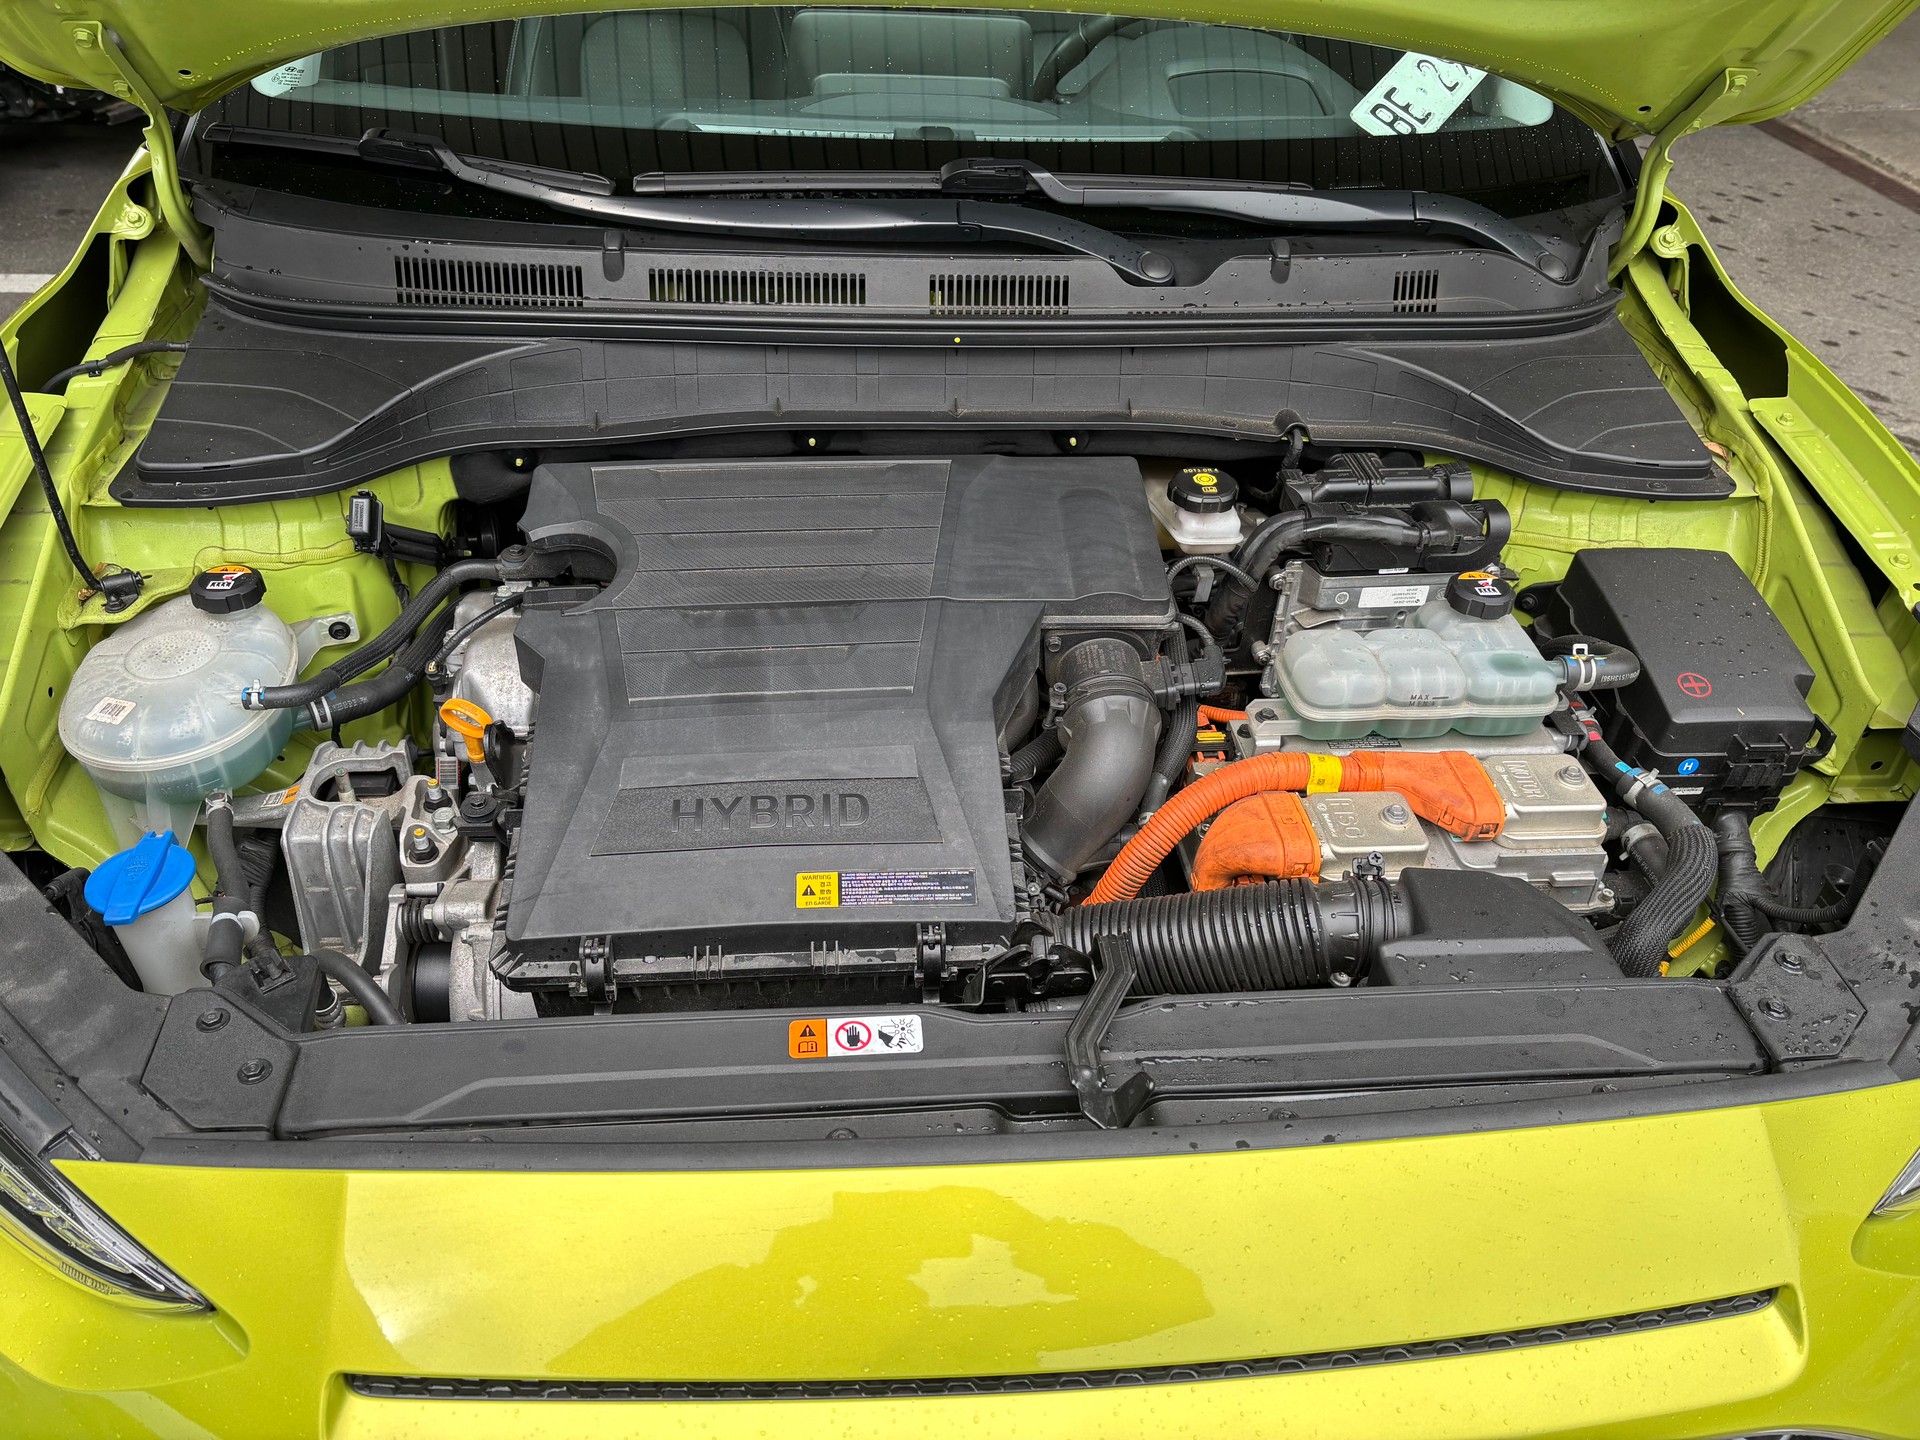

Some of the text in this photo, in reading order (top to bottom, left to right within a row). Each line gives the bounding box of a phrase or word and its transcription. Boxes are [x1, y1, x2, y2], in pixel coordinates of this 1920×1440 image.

[1506, 763, 1546, 799] MOTOR
[1683, 762, 1694, 771] H
[671, 793, 870, 833] HYBRID
